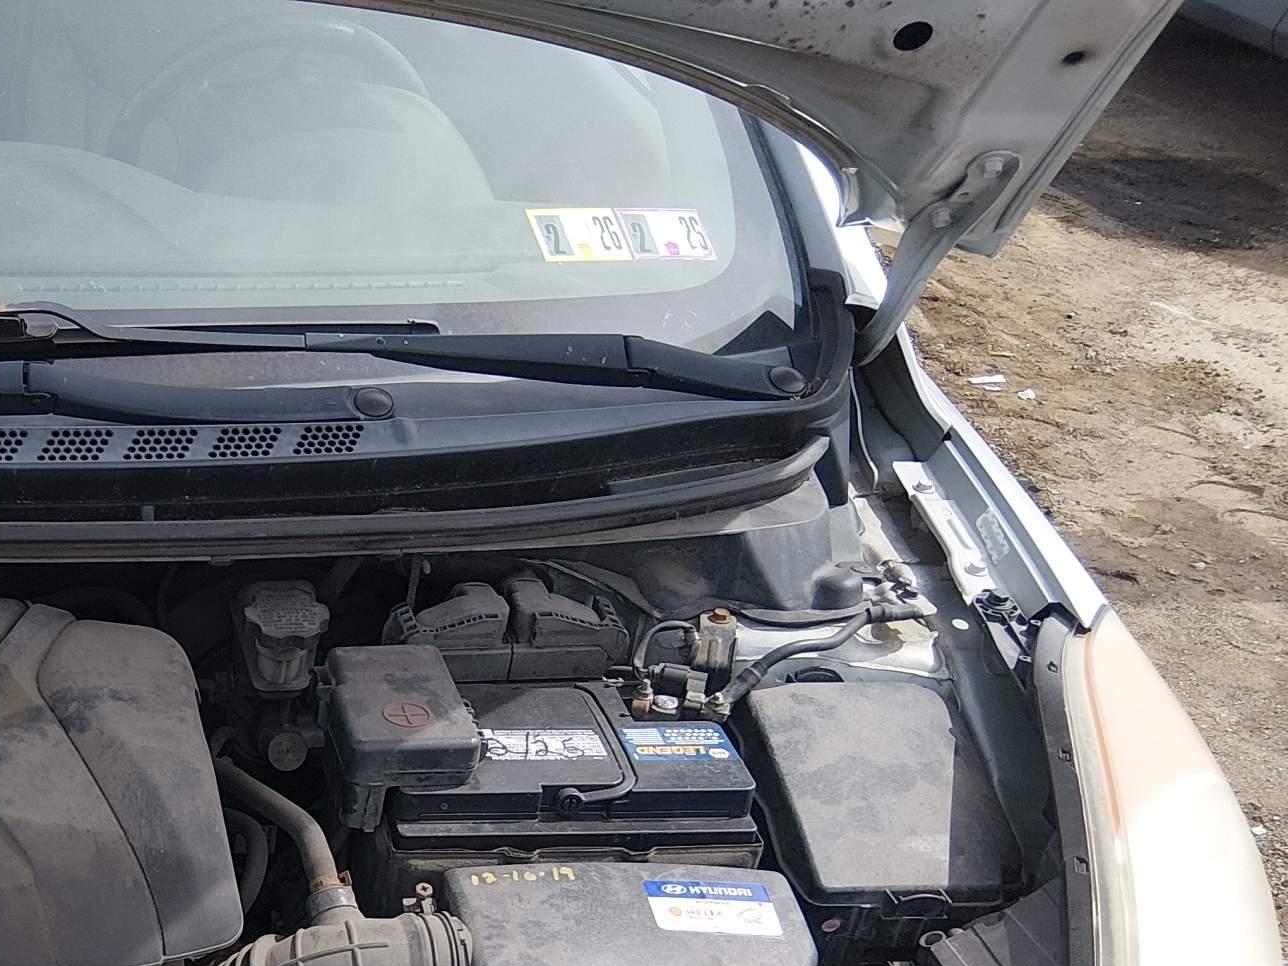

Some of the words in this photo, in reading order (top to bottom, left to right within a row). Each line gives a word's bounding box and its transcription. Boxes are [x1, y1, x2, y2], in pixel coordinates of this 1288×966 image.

[545, 223, 567, 255] 2
[592, 215, 622, 251] 26
[631, 222, 652, 253] 2
[679, 215, 709, 251] 25
[636, 745, 706, 756] LEGEND
[689, 885, 753, 897] HYUNDAI
